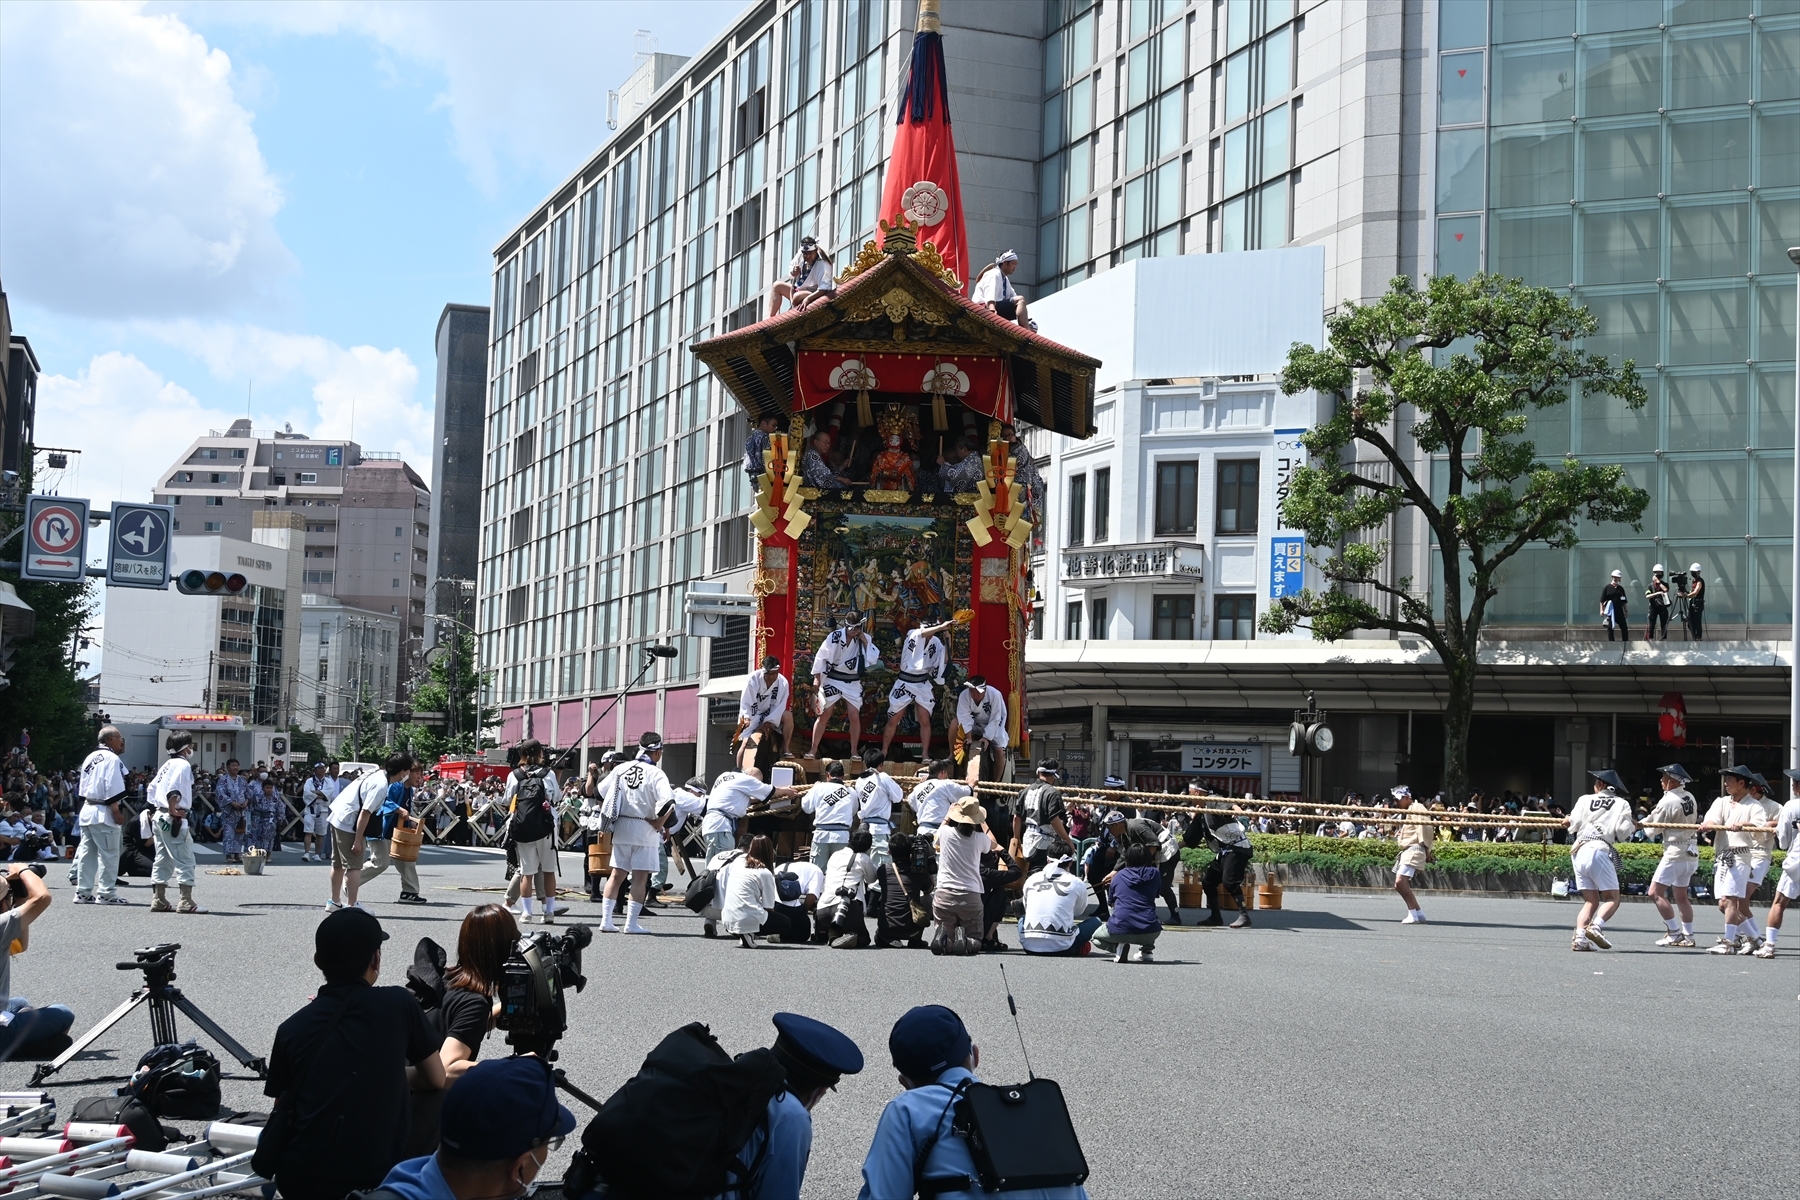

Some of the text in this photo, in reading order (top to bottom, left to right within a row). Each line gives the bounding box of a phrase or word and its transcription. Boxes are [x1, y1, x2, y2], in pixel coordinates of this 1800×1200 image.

[114, 562, 163, 576] 路線バスを除く
[1067, 551, 1167, 576] 池善化粧品店
[1274, 542, 1286, 596] 買えます
[1288, 544, 1300, 571] すぐ
[1192, 758, 1252, 770] コンタクト
